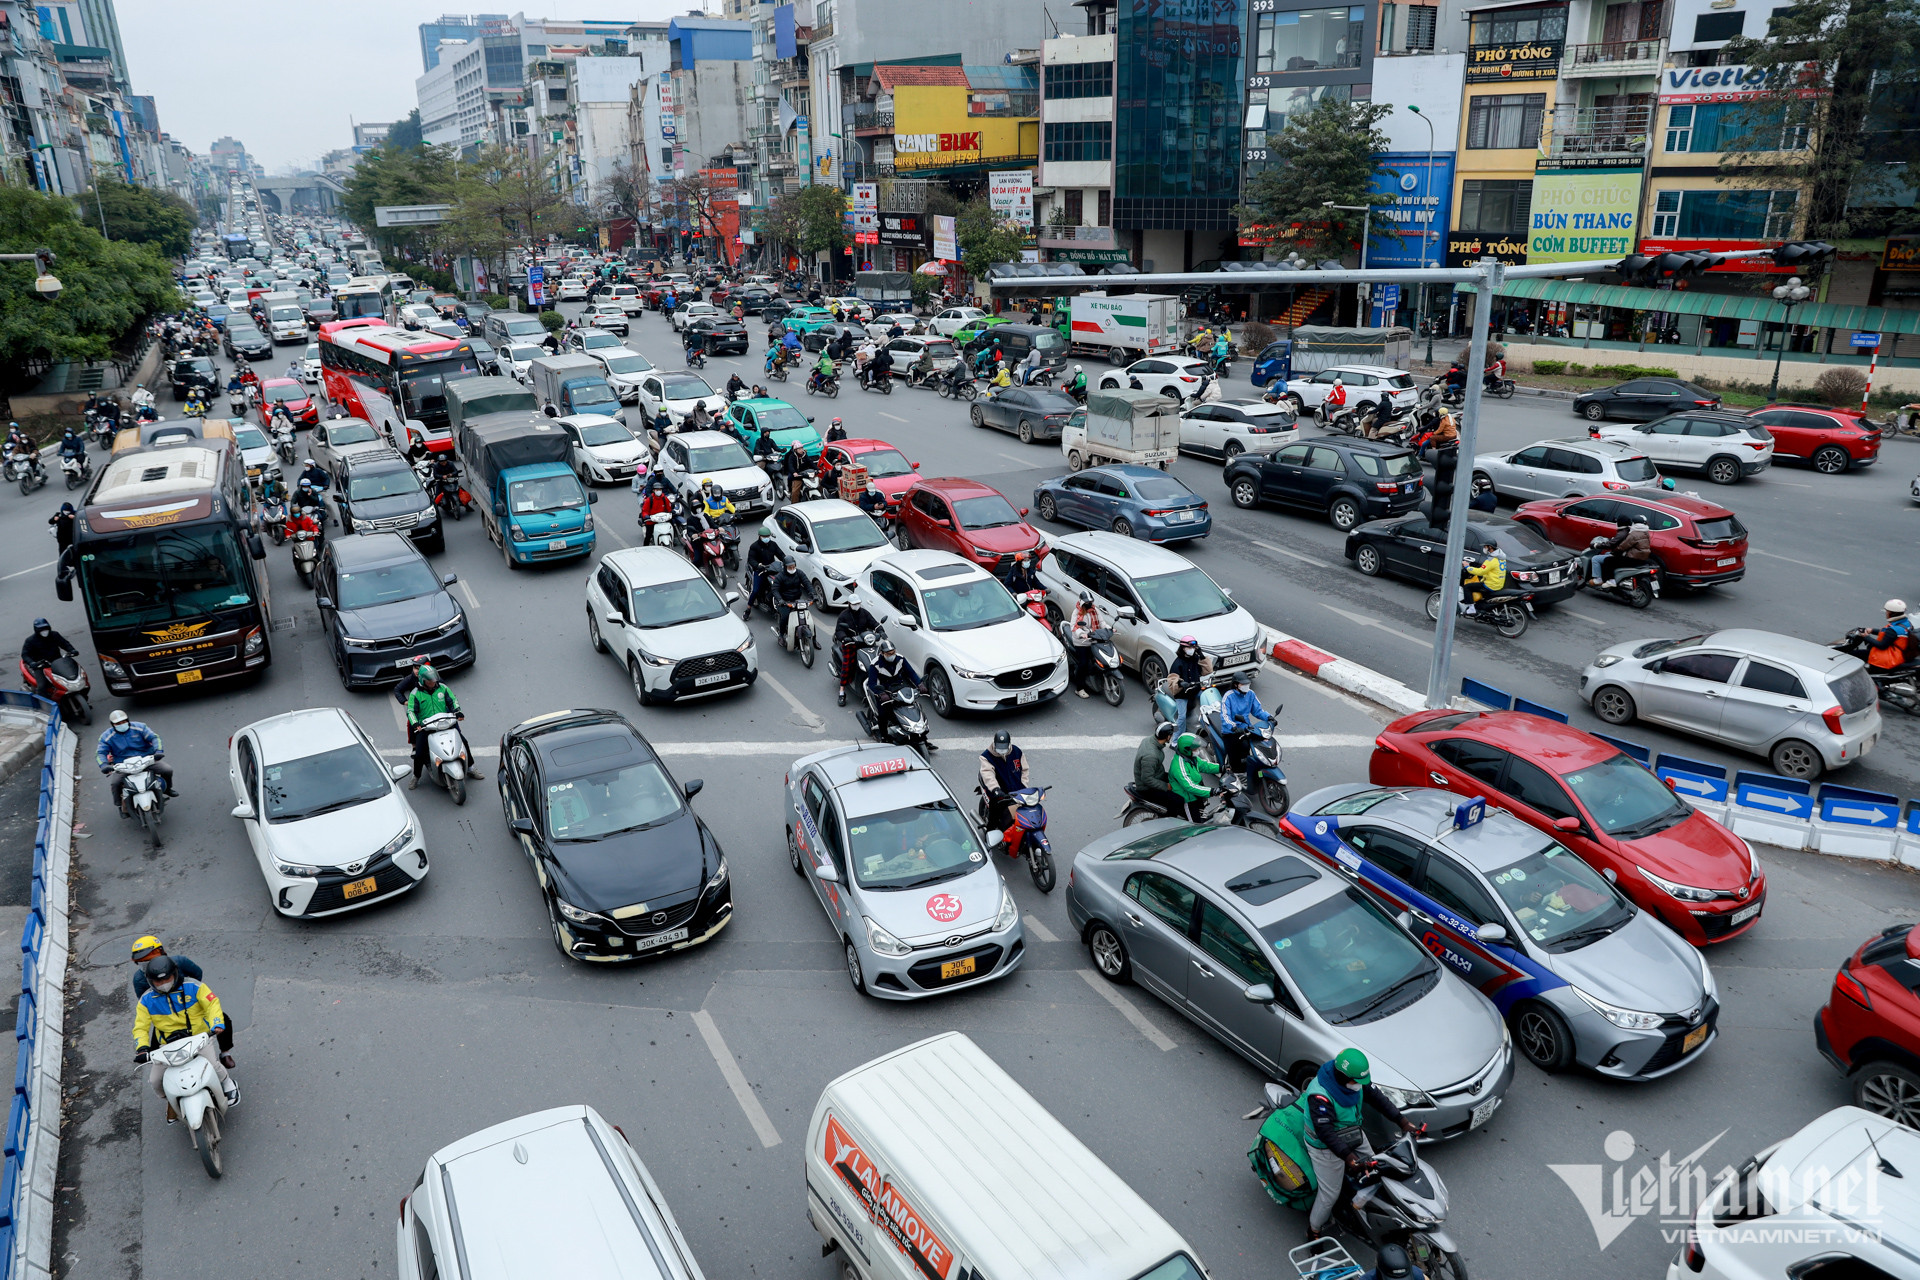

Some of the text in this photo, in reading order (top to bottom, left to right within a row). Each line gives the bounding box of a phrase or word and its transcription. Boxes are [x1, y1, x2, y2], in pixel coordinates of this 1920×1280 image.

[1253, 0, 1274, 11] 393
[1510, 42, 1553, 61] TỐNG
[1481, 66, 1500, 74] NGON
[1250, 76, 1271, 87] 393
[940, 131, 979, 152] BUK
[894, 156, 916, 166] BUFFET
[1246, 150, 1267, 160] 393
[1019, 186, 1032, 194] NAM
[1581, 183, 1633, 206] CHÚC
[1533, 208, 1633, 229] BÚN THANG
[1533, 234, 1629, 254] CƠM BUFFET
[123, 513, 182, 529] LIMOUSINE
[150, 627, 207, 645] LIMOUSINE
[149, 649, 173, 658] 0974
[862, 758, 905, 776] Taxi 123
[352, 880, 367, 889] 30K
[929, 894, 960, 918] 123
[939, 910, 956, 920] Taxi
[951, 960, 966, 970] 30E
[1445, 949, 1473, 972] TAXI
[851, 1153, 944, 1269] LALAMOVE
